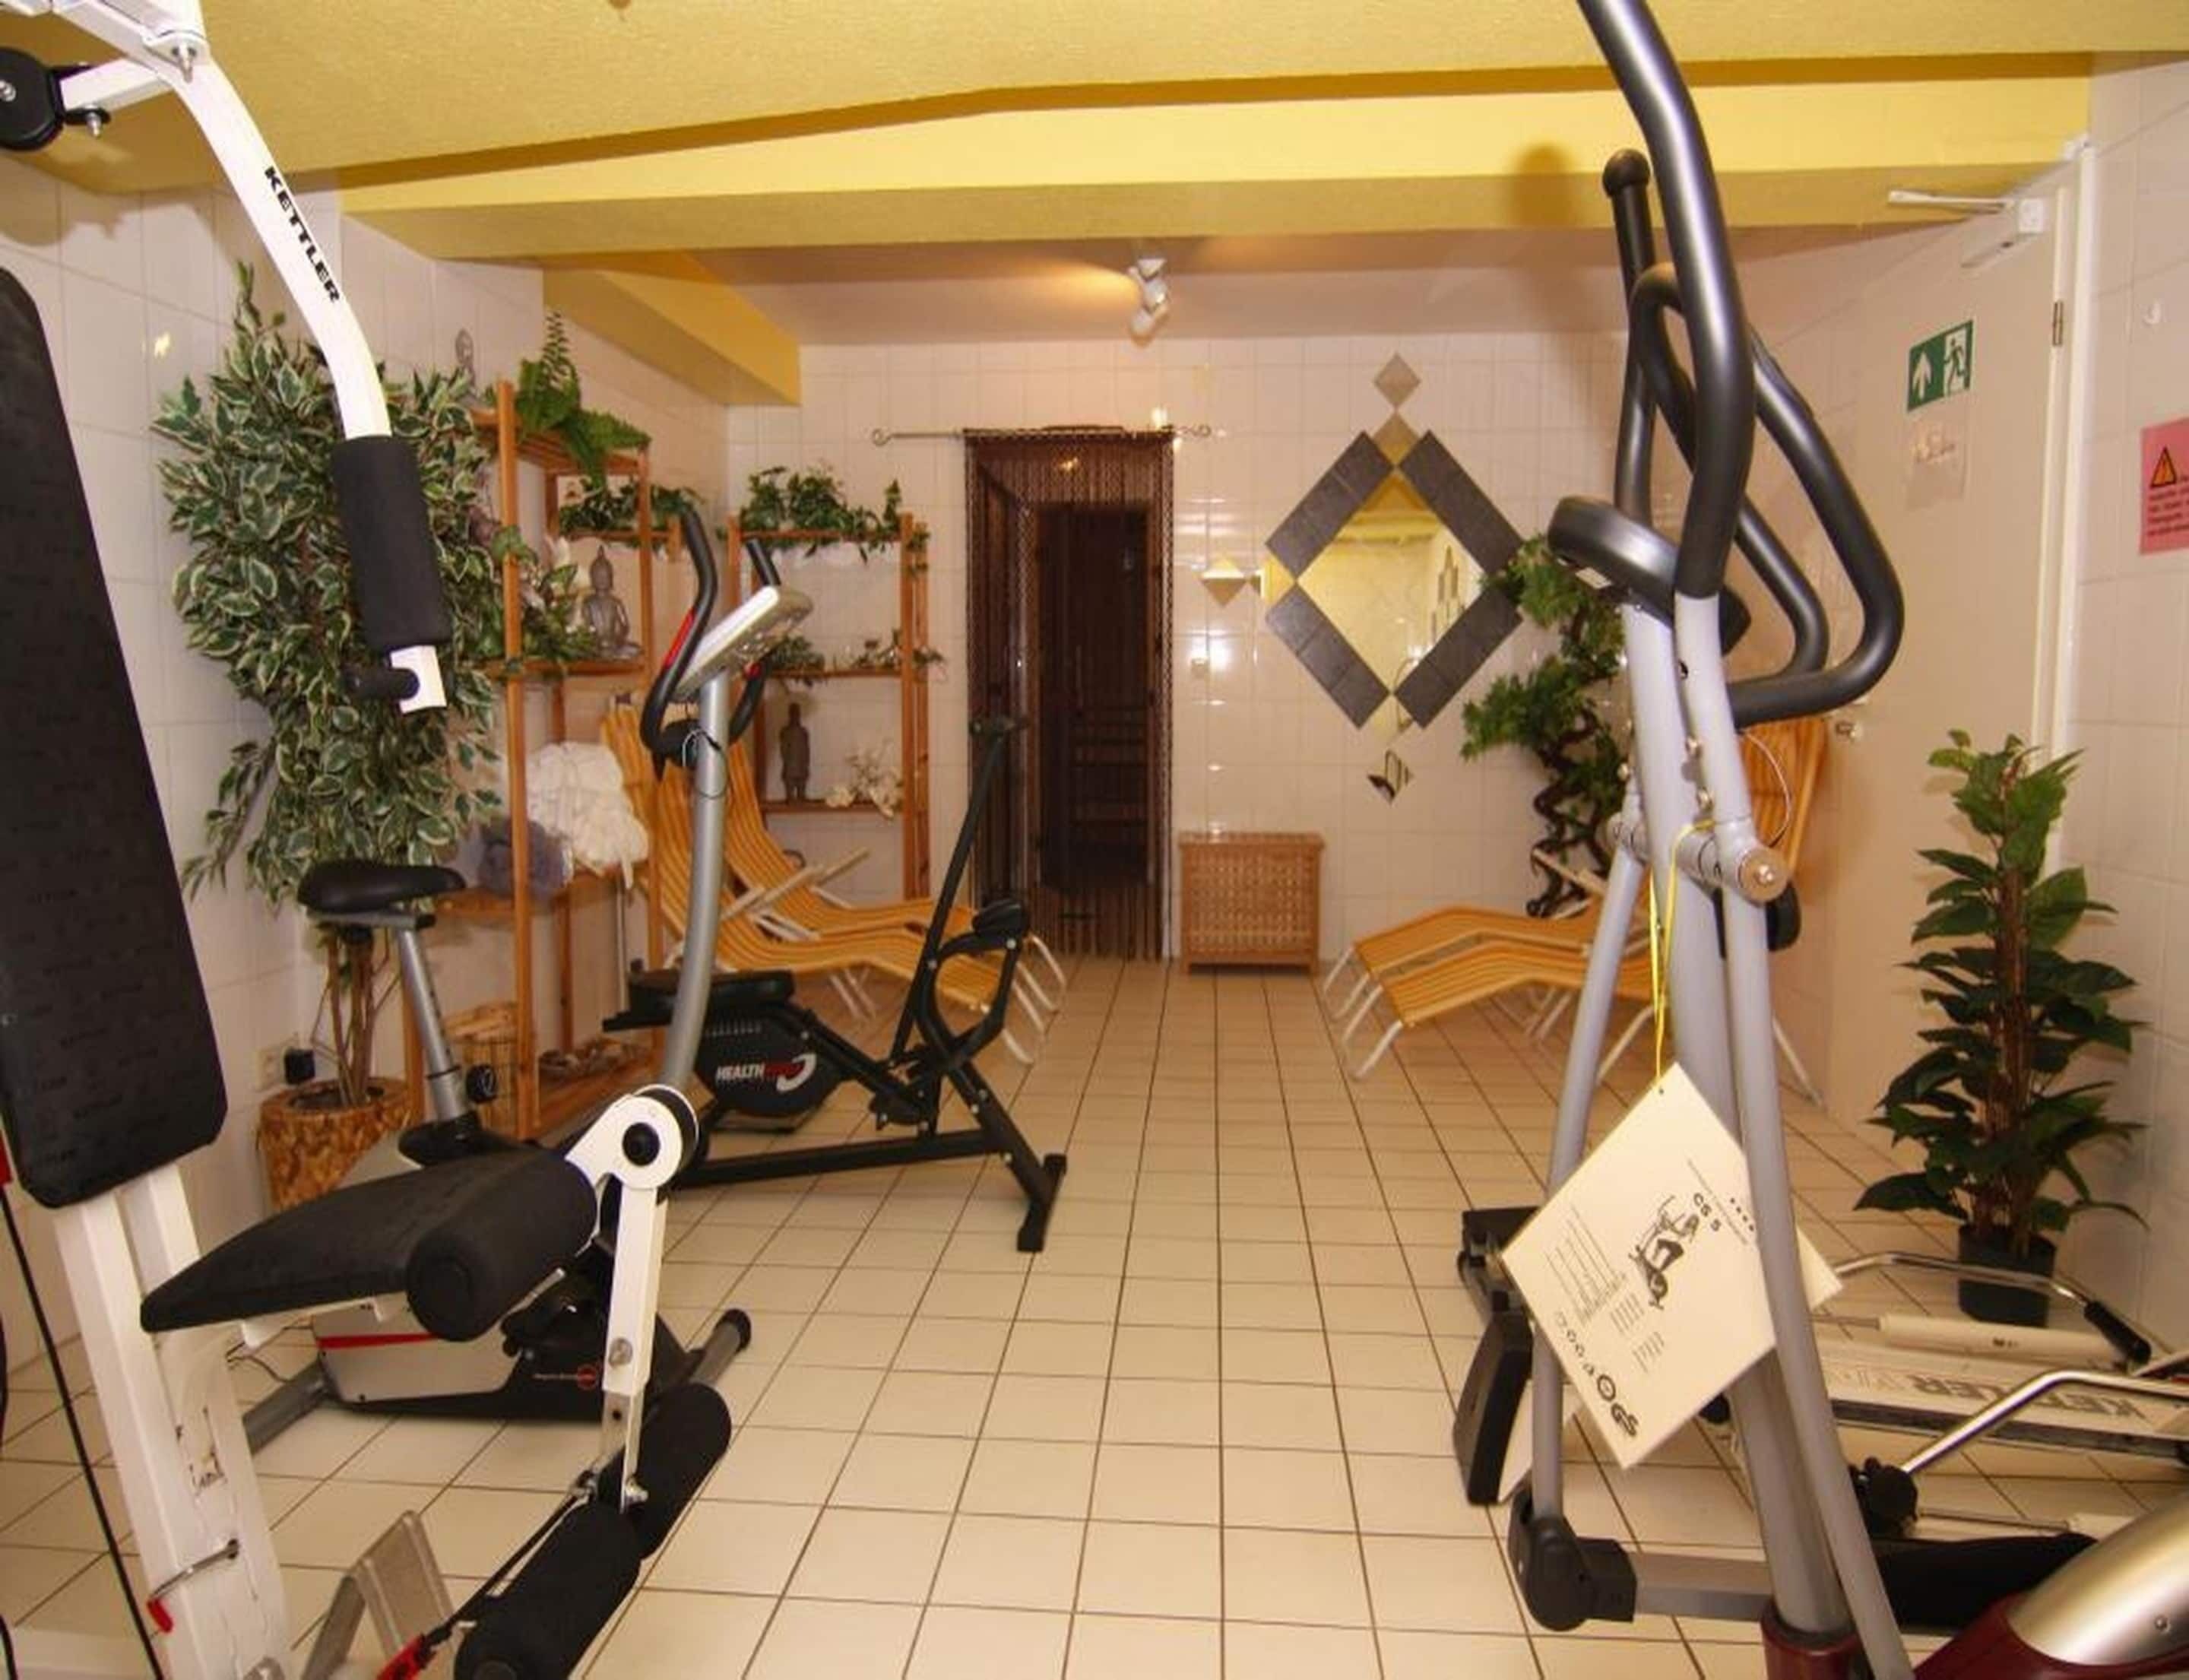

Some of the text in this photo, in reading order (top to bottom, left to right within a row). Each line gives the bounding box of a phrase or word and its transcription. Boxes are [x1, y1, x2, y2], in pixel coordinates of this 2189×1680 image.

[265, 166, 339, 303] KETTLER
[715, 1062, 765, 1081] HEALTH
[1906, 1374, 2149, 1422] KETLER
